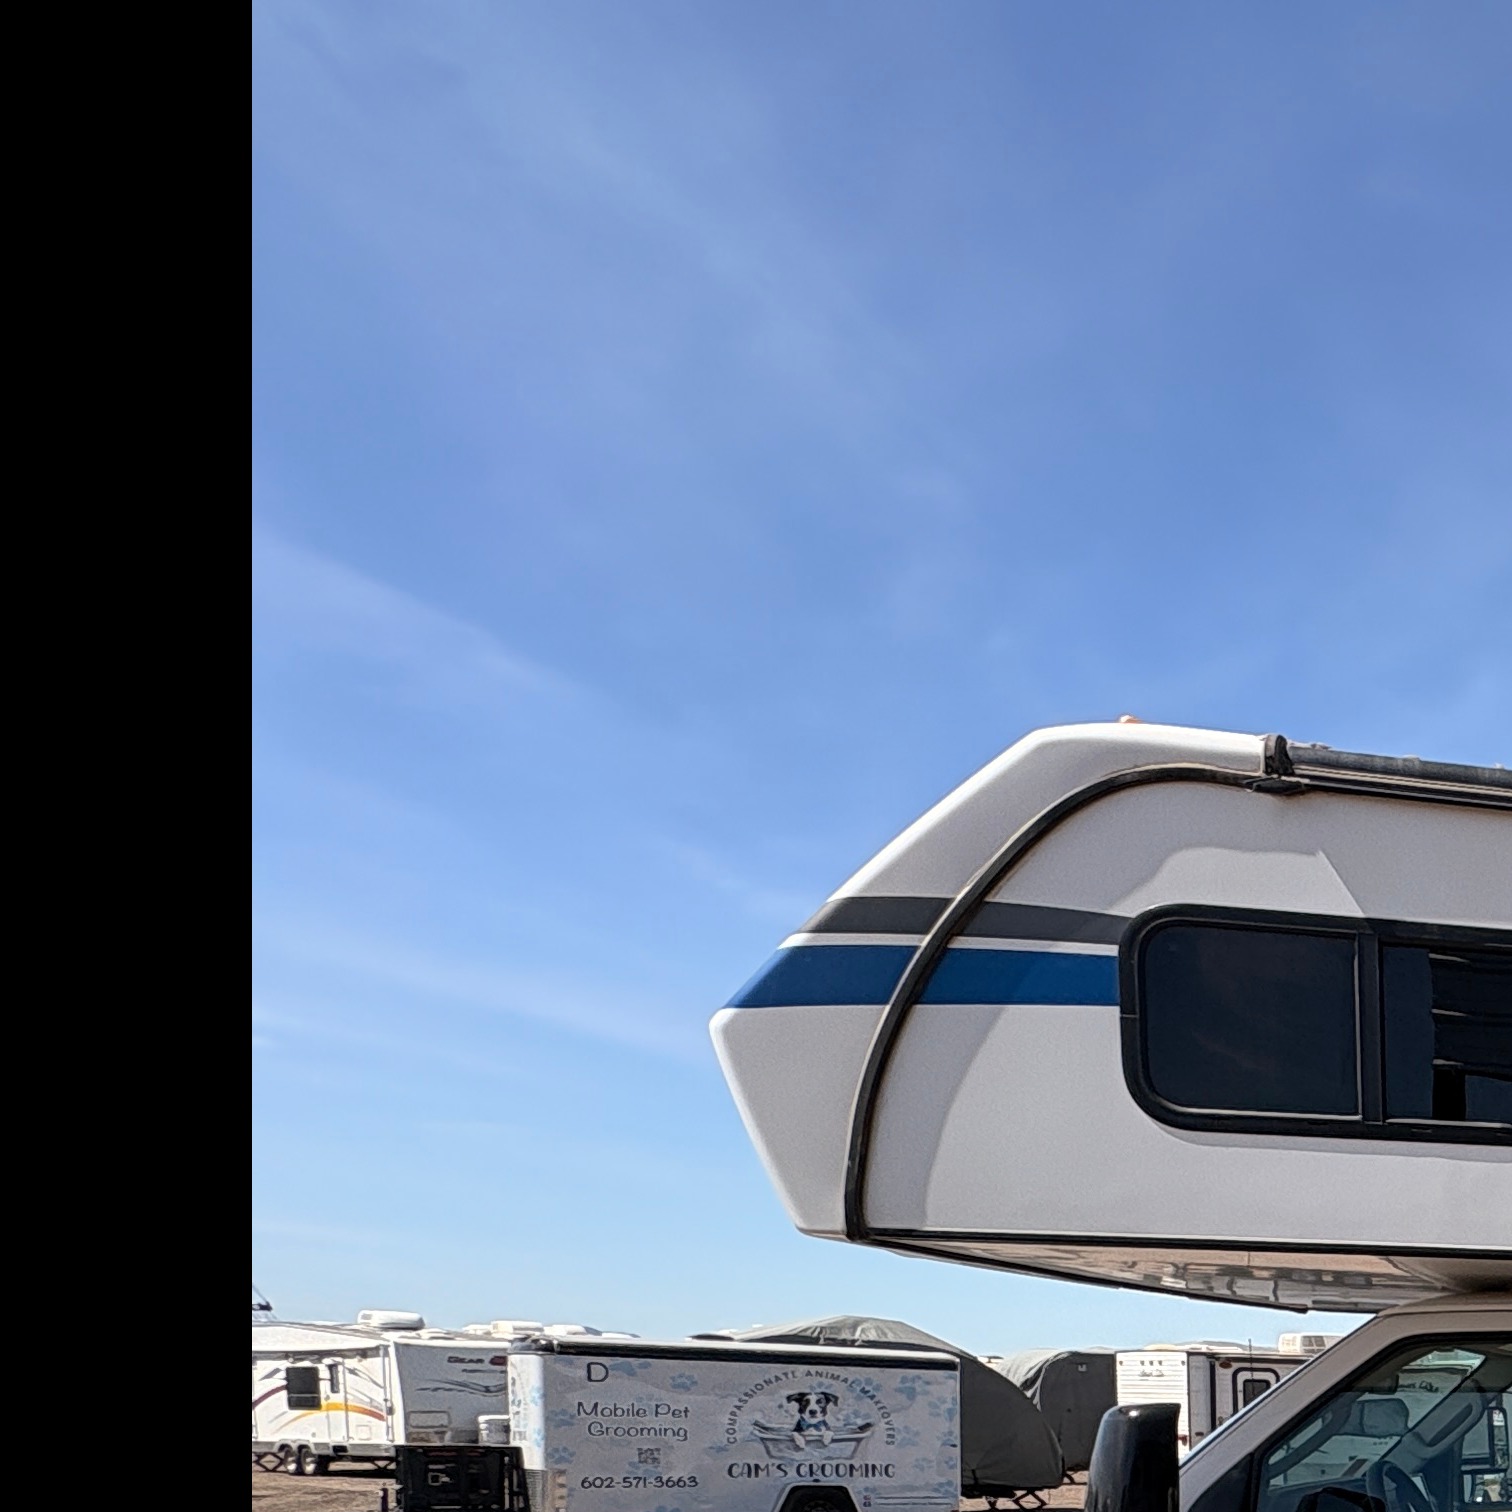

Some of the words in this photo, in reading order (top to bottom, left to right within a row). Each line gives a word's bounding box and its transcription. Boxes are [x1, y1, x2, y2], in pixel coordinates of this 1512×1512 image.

[586, 1361, 609, 1383] D
[577, 1401, 649, 1418] Mobile
[655, 1403, 690, 1419] Pet
[726, 1370, 797, 1445] COMPASSIONATE
[805, 1370, 856, 1389] ANIMAL
[859, 1386, 896, 1446] MAKEOVERS
[587, 1421, 689, 1441] Grooming
[727, 1462, 789, 1478] CAM'S
[796, 1462, 896, 1478] GROOMING
[581, 1476, 699, 1489] 602-571-3663
